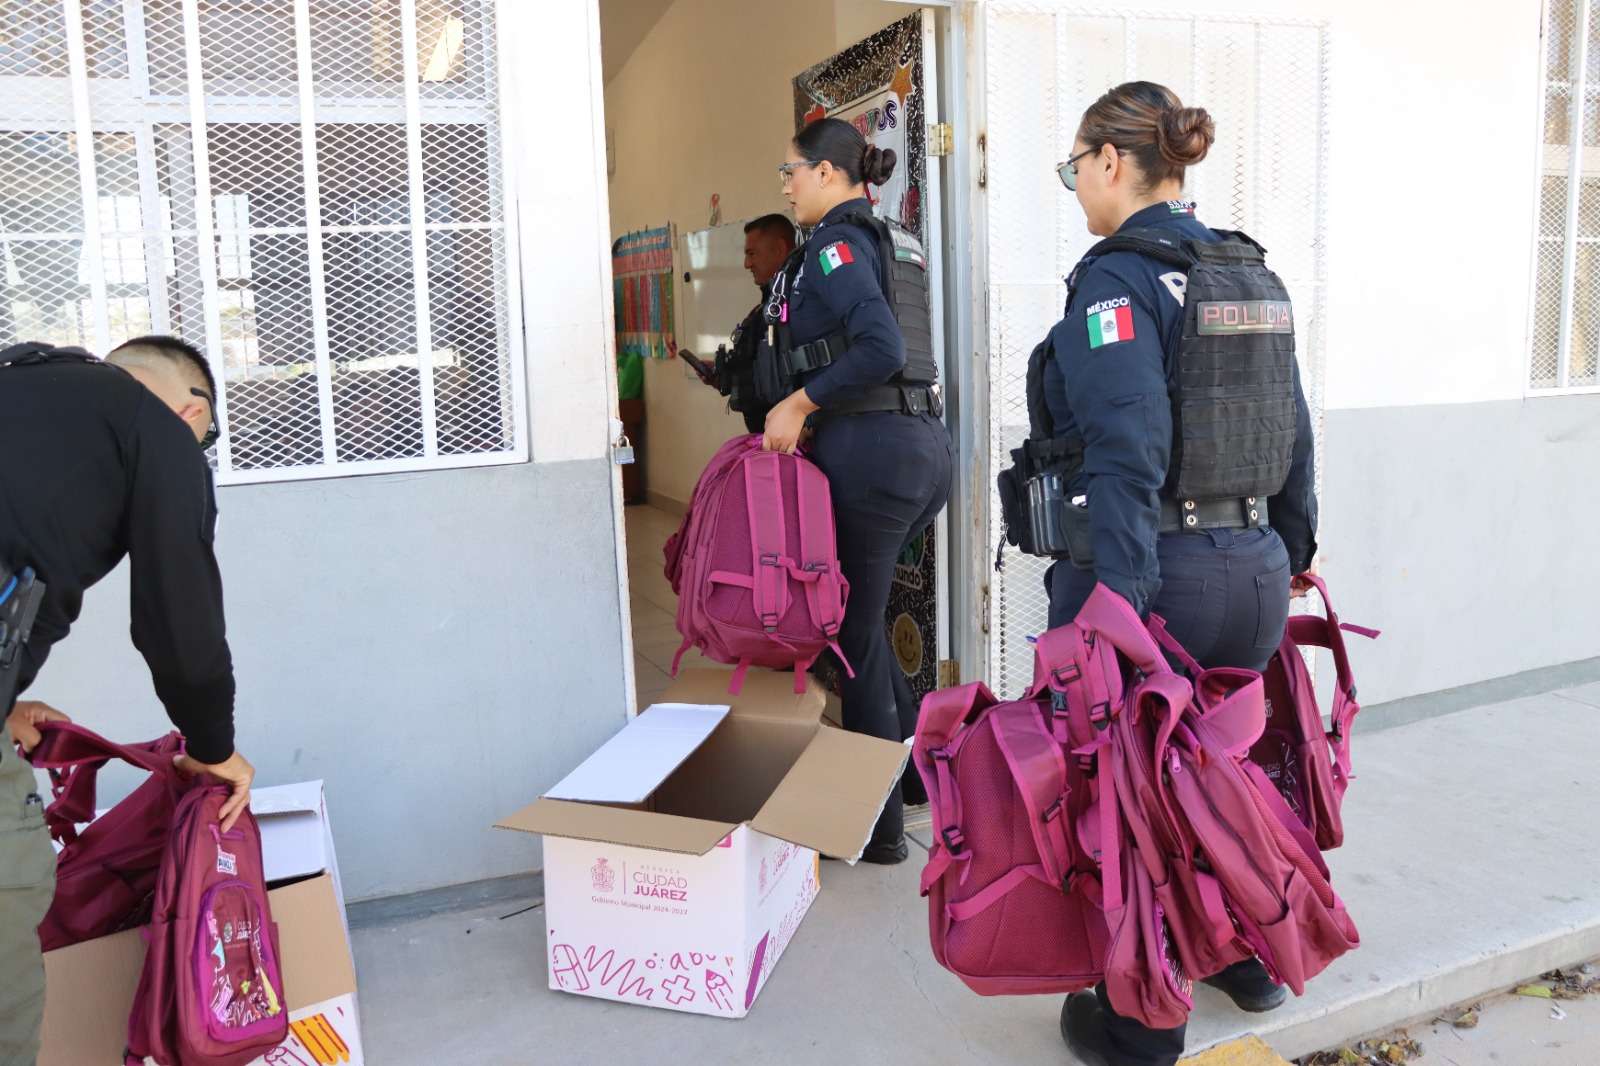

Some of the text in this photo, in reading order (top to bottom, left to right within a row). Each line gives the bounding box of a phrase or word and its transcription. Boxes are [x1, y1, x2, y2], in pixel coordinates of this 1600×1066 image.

[1086, 297, 1129, 316] MÉXICO
[1202, 303, 1290, 327] POLICIA
[632, 871, 688, 889] CIUDAD
[633, 884, 688, 901] JUÁREZ
